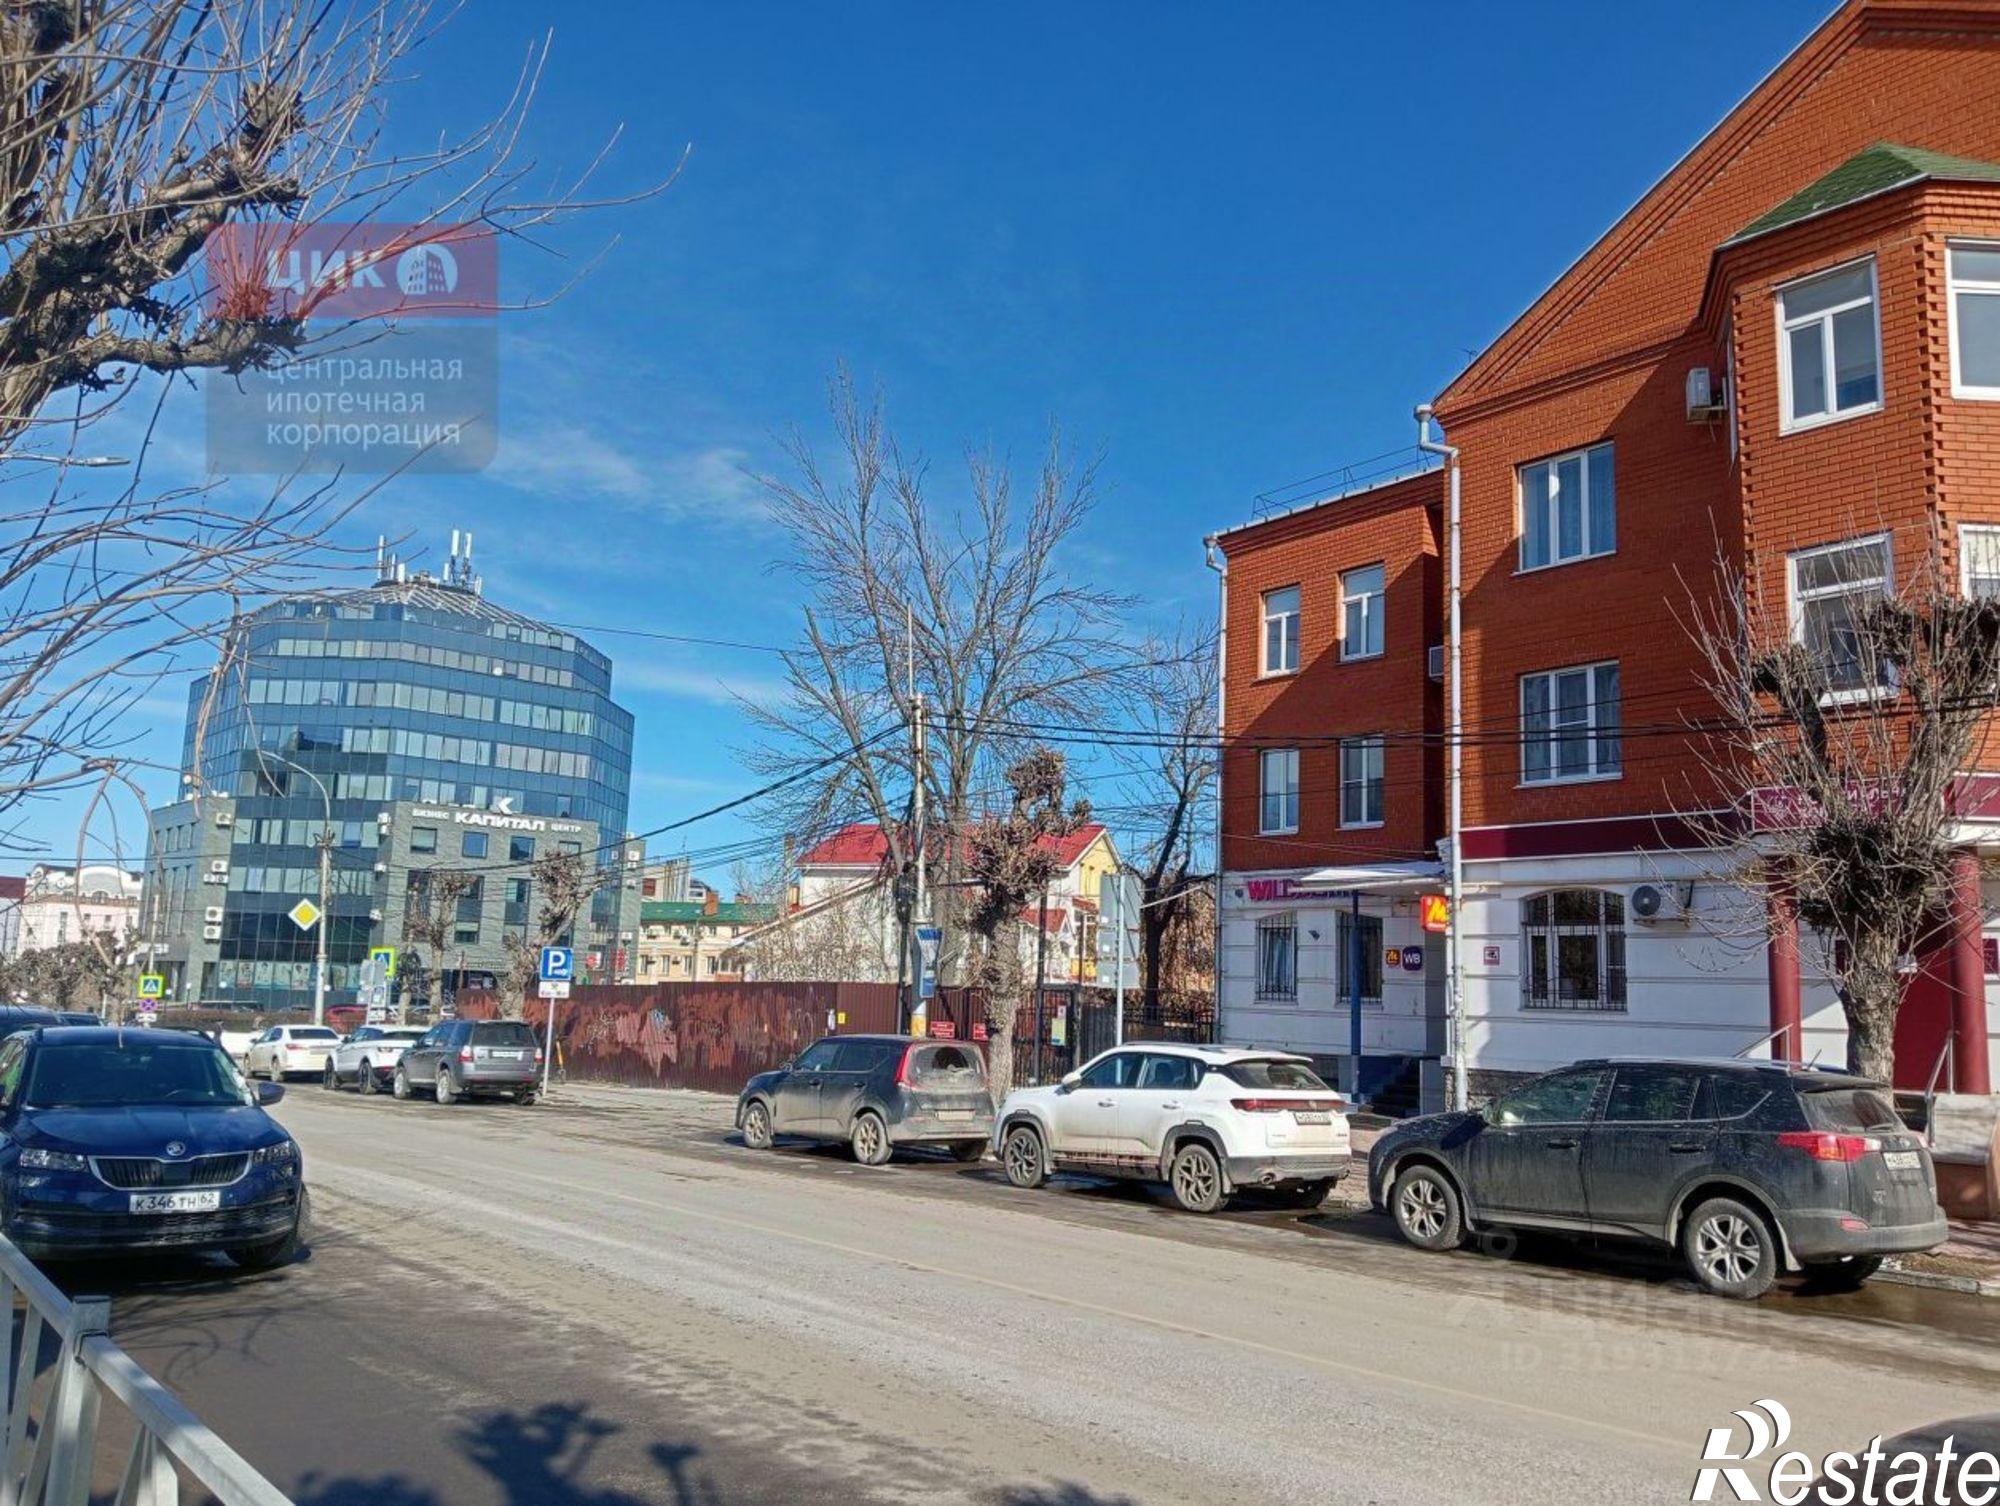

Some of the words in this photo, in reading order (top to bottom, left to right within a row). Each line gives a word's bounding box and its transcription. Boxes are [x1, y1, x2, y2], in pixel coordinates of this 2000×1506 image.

[412, 808, 450, 820] БИЗНЕС
[455, 811, 546, 832] КАПИТАЛ
[551, 822, 582, 833] ЦЕНТР
[548, 950, 566, 977] P
[1403, 952, 1420, 964] WB
